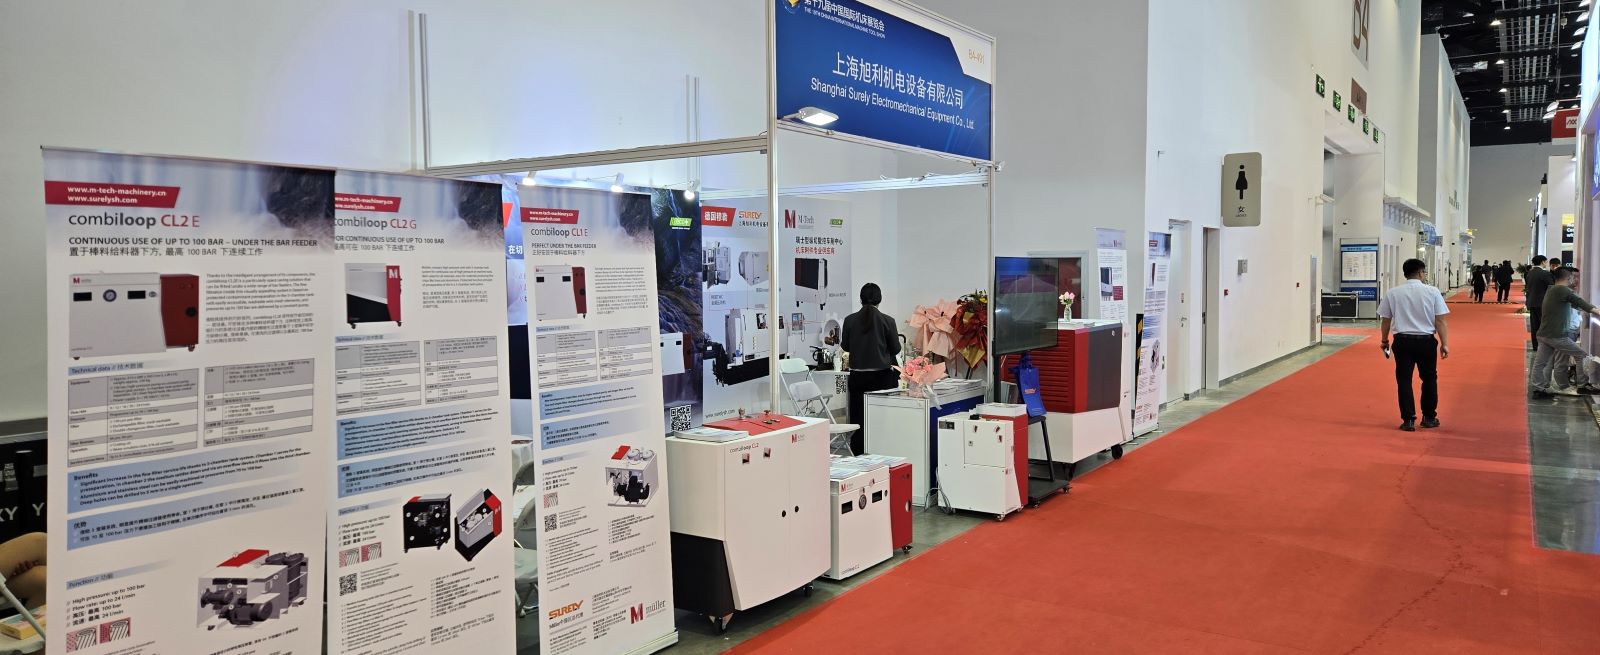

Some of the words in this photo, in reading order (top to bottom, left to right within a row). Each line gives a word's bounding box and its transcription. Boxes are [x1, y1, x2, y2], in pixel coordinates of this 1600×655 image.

[832, 52, 963, 110] 上海旭利机电设备有限公司
[811, 78, 847, 99] Shanghai
[848, 88, 870, 106] Surely
[872, 93, 926, 117] Electromechanical
[927, 108, 955, 125] Equipment
[67, 186, 166, 198] www.m-tech-machinery.cn
[67, 195, 138, 205] www.surelysh.com
[739, 211, 762, 219] SURELY
[785, 209, 795, 228] M
[68, 213, 156, 230] combiloop
[161, 214, 189, 227] CL2
[192, 215, 200, 227] E
[390, 219, 407, 228] CL2
[410, 220, 416, 229] G
[531, 227, 570, 238] combiloop
[572, 228, 583, 237] CL1
[584, 228, 588, 236] E
[68, 237, 130, 245] CONTINUOUS
[389, 269, 398, 279] M
[631, 603, 643, 624] M
[646, 600, 666, 614] müller
